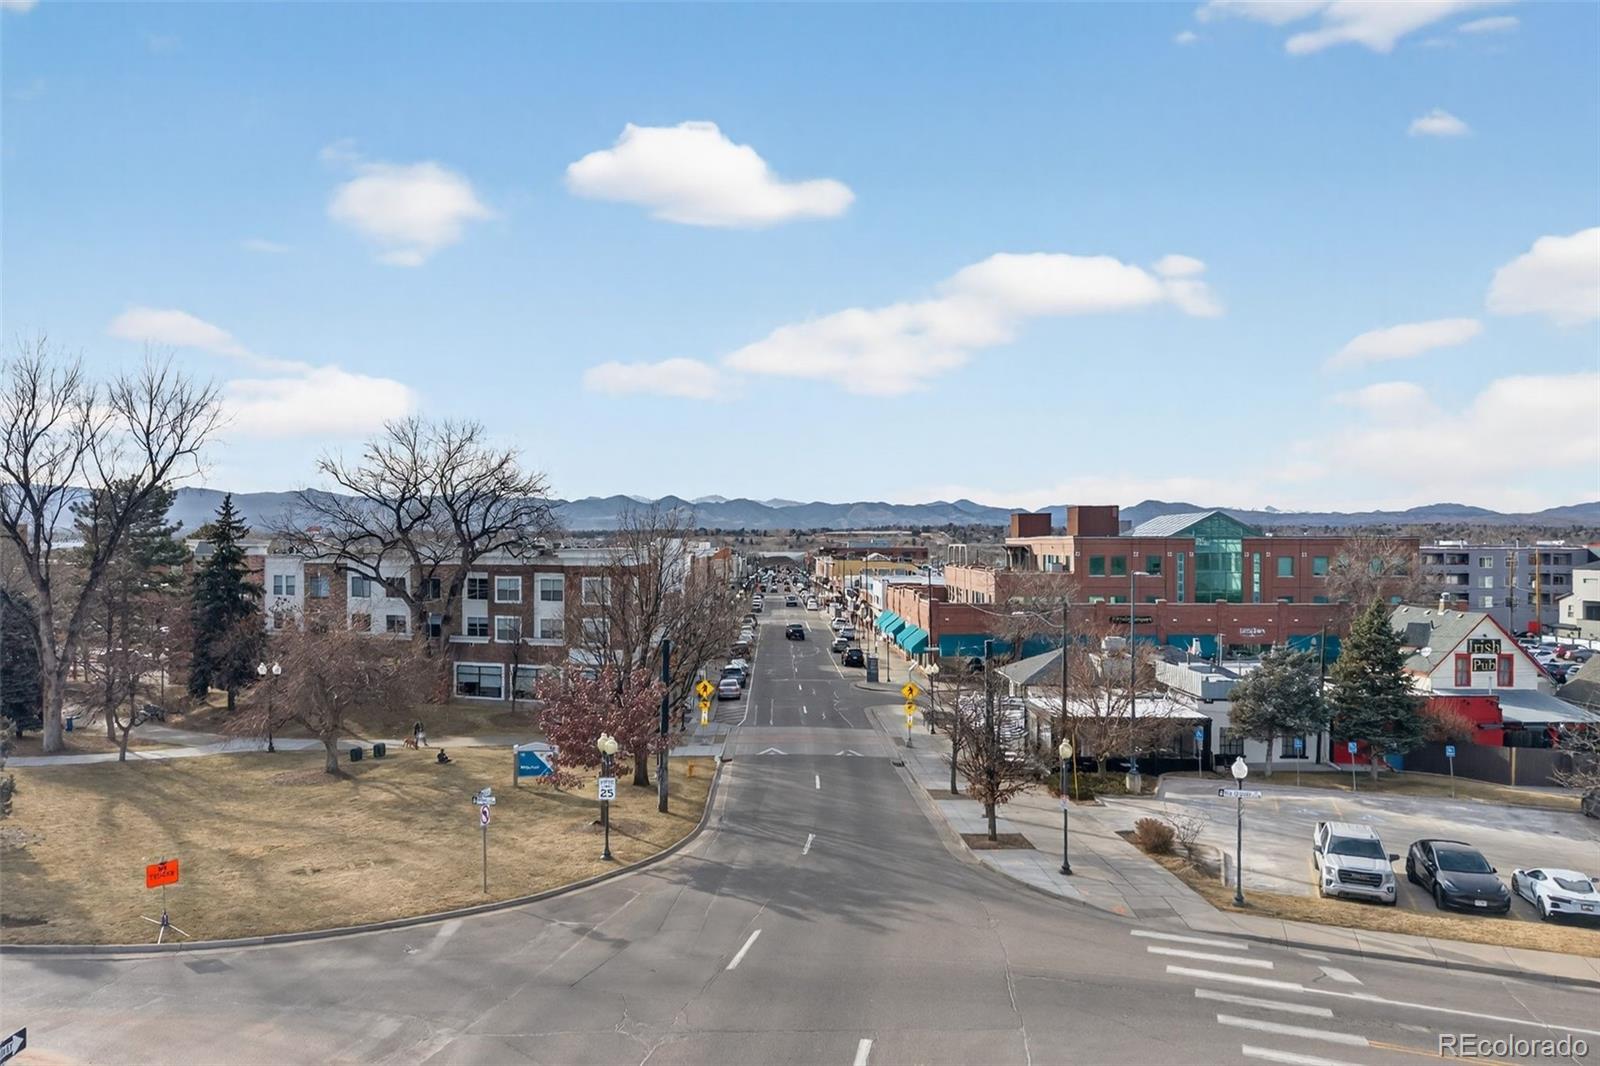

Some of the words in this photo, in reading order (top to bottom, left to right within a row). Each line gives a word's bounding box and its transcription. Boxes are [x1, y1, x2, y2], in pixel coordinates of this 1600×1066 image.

[1469, 639, 1500, 654] Irish
[1473, 659, 1496, 671] Pub
[600, 788, 614, 798] 25
